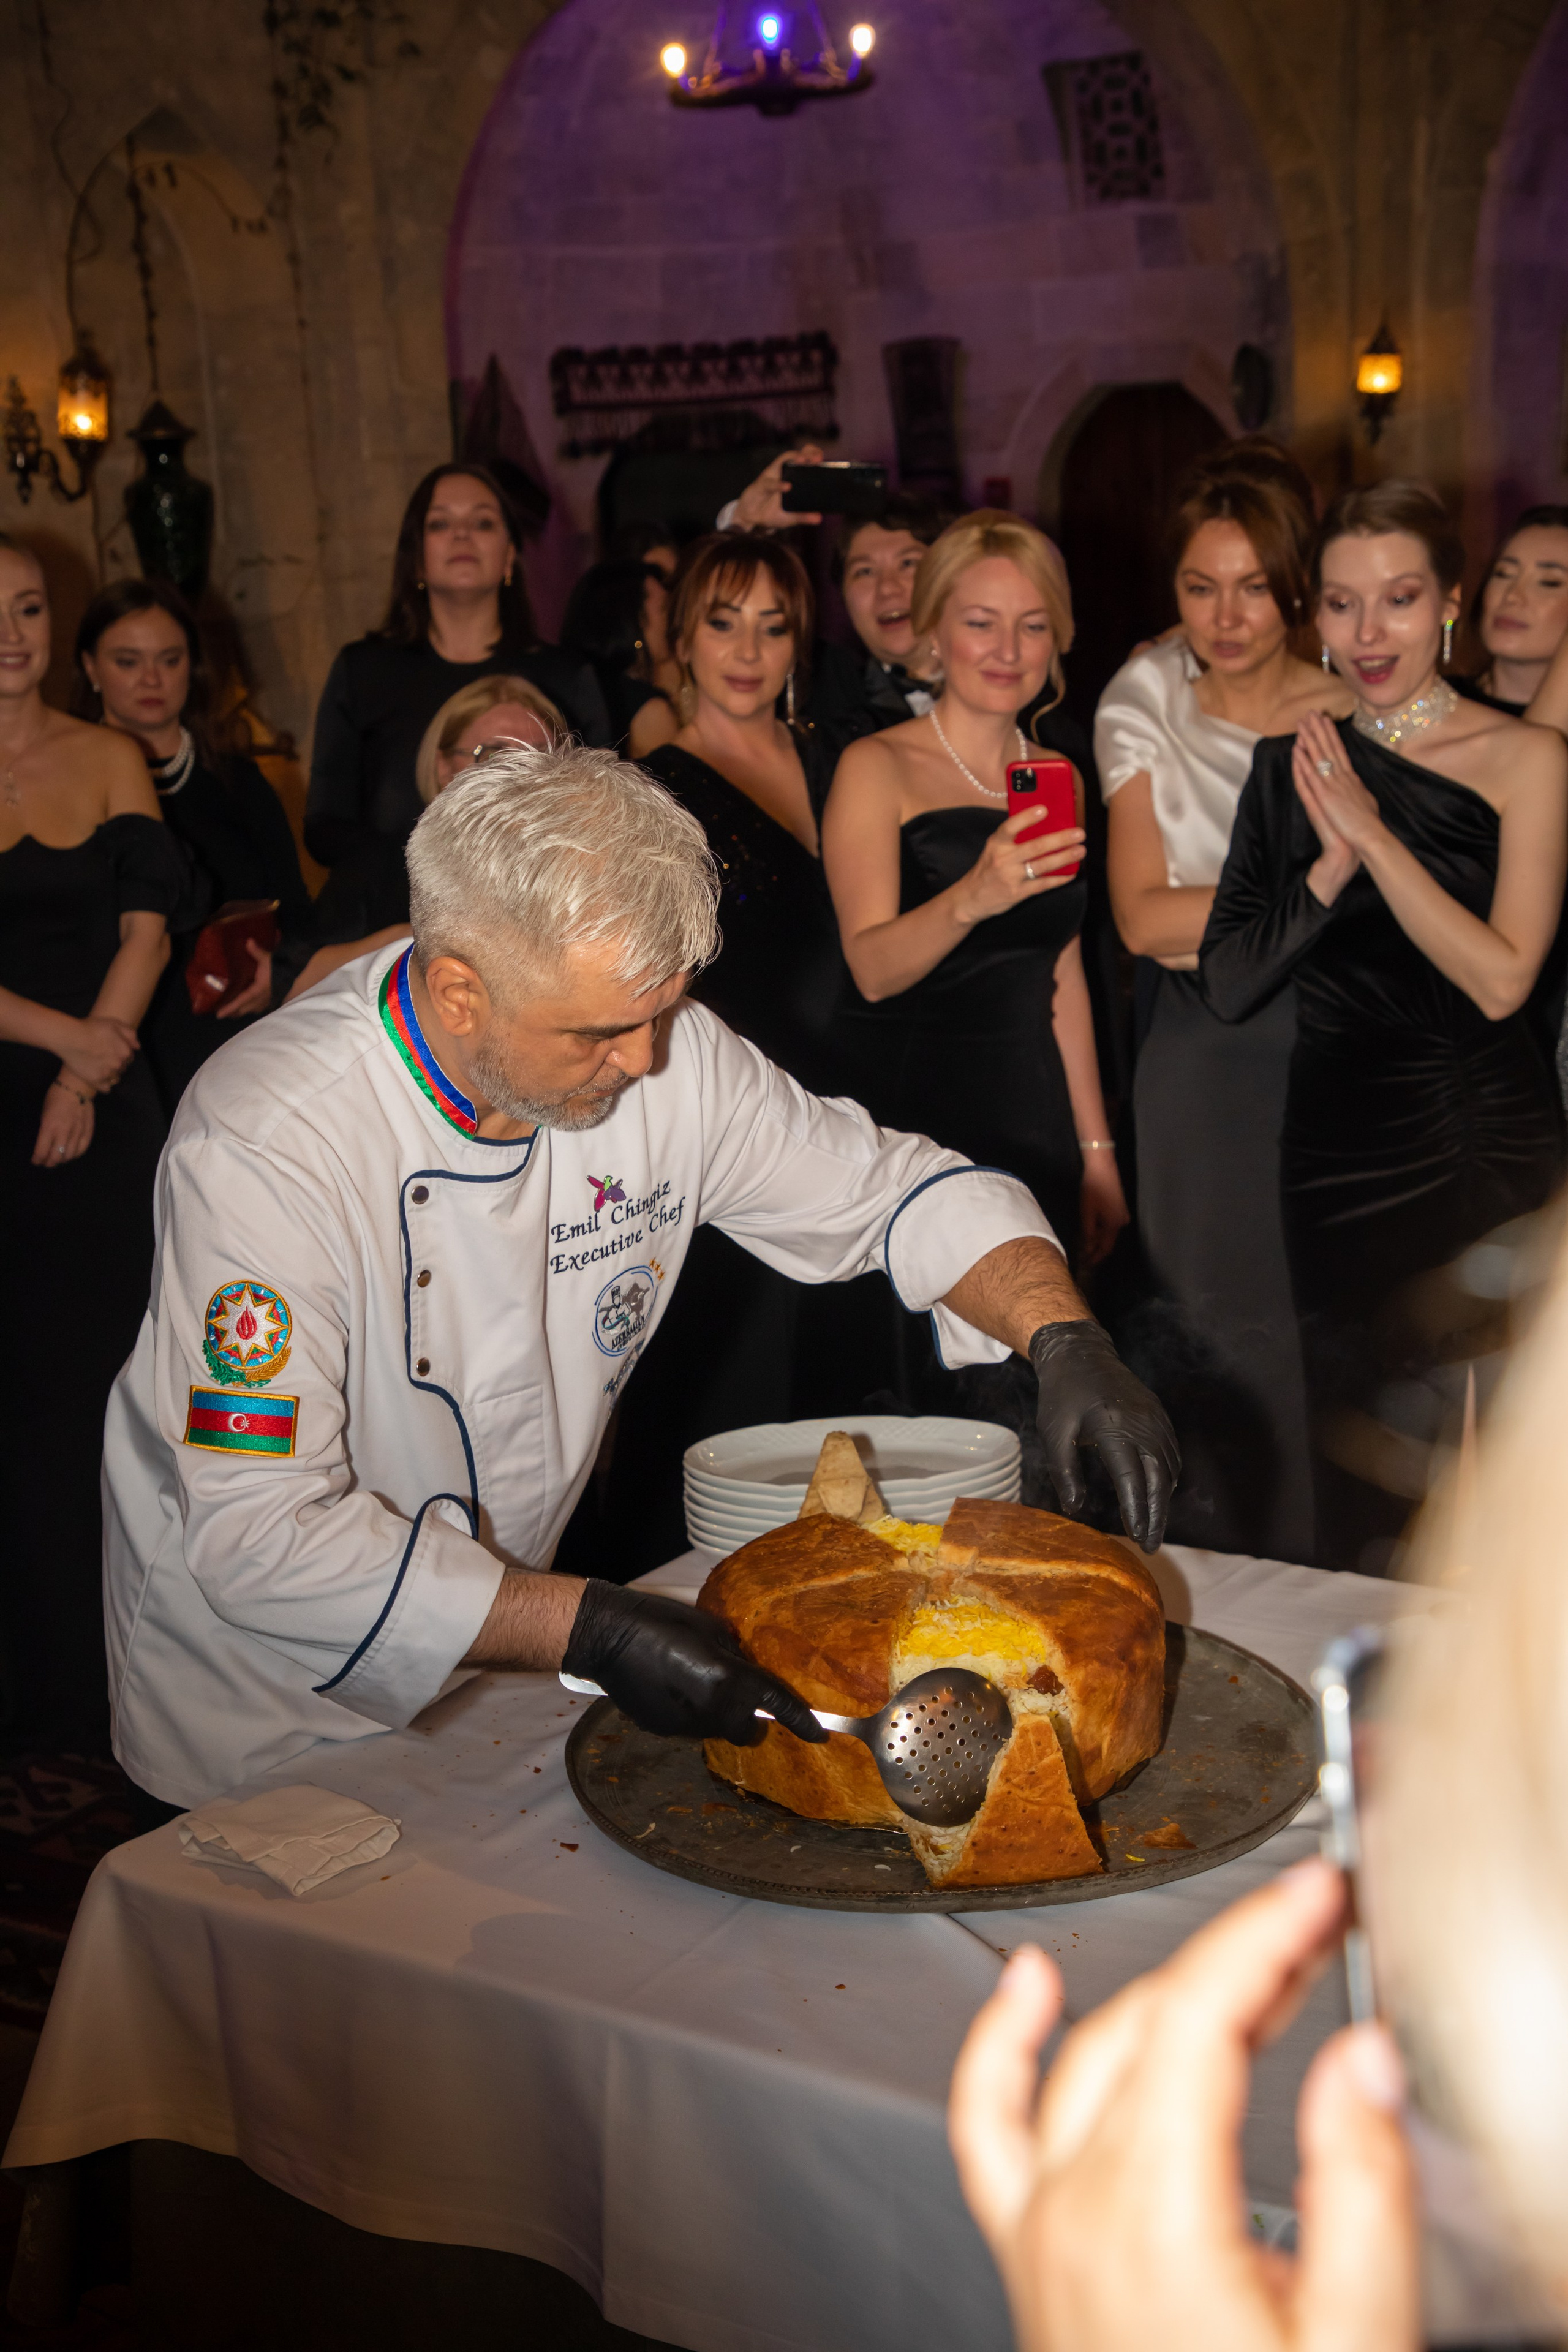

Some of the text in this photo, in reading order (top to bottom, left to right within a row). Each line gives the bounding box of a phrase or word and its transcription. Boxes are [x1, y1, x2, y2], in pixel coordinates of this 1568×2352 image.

[550, 1196, 685, 1274] Executive Chef
[551, 1180, 671, 1243] Emil Chingiz
